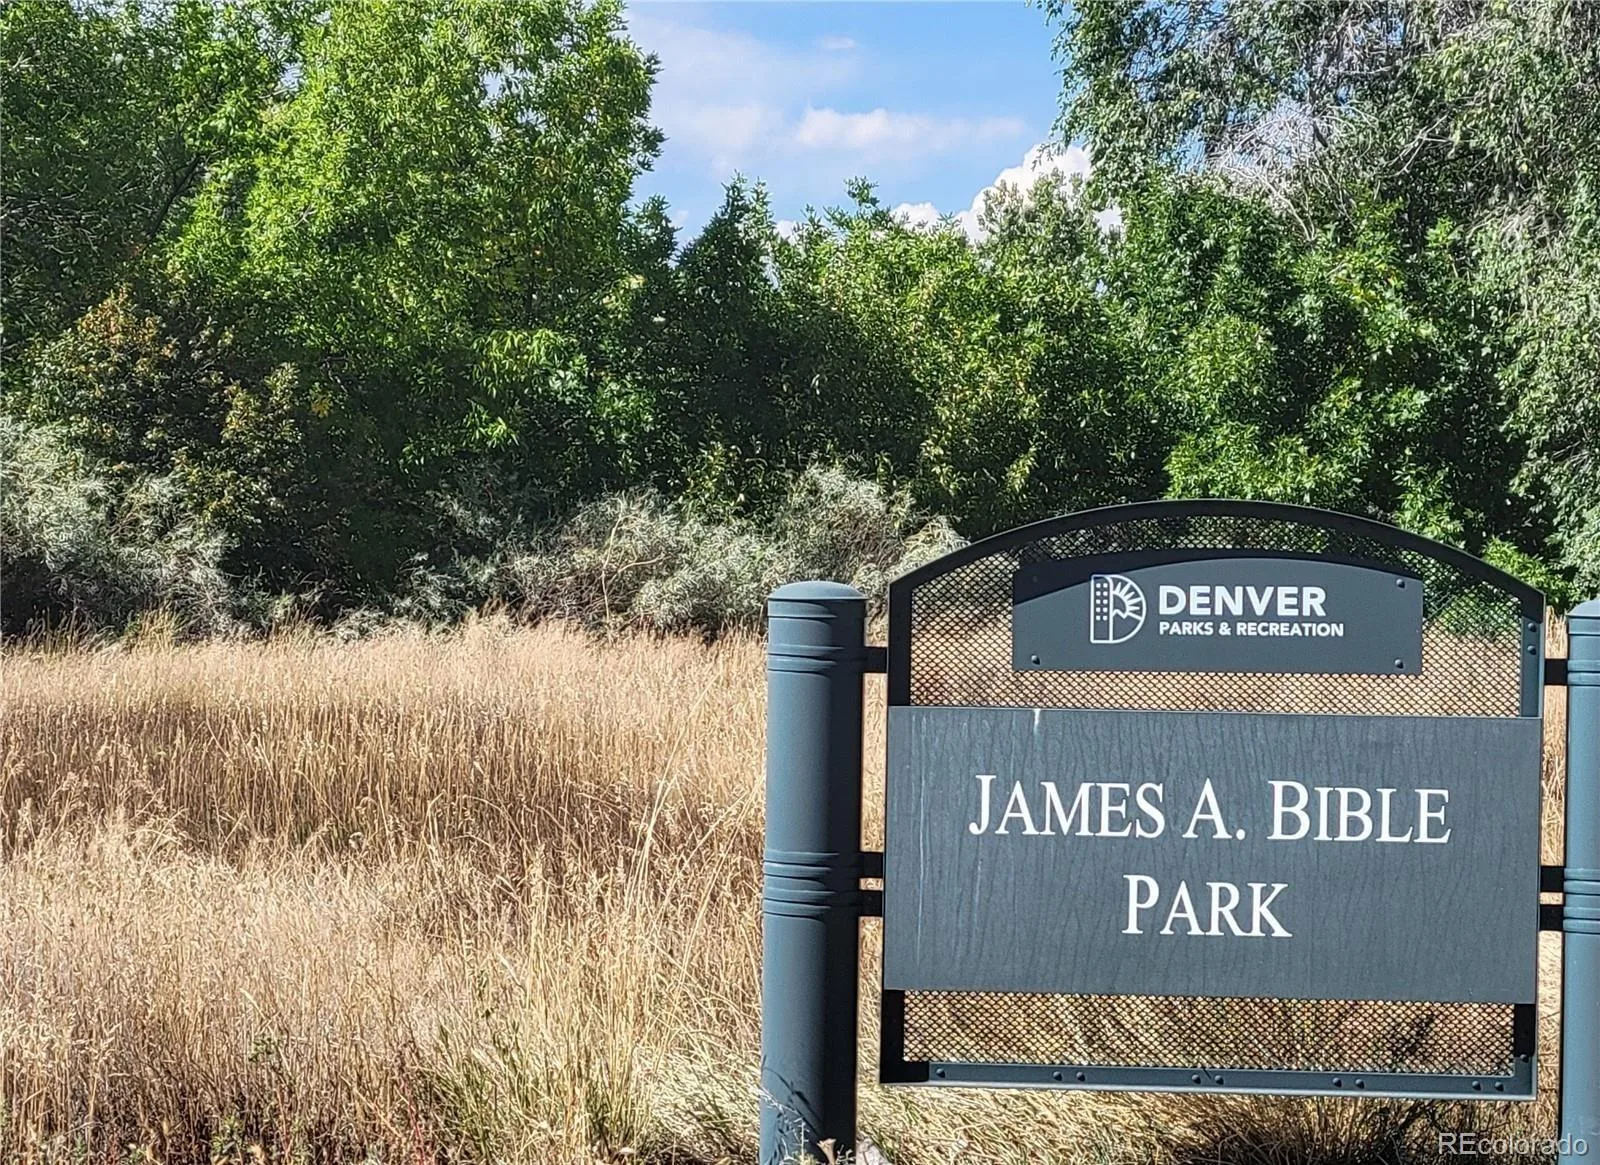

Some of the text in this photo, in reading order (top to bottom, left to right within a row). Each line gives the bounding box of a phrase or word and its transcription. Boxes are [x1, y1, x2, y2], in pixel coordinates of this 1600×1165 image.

[1159, 585, 1326, 617] DENVER
[1159, 621, 1344, 637] PARKS & RECREATION
[968, 774, 1452, 844] JAMES A. BIBLE
[1122, 874, 1293, 938] PARK
